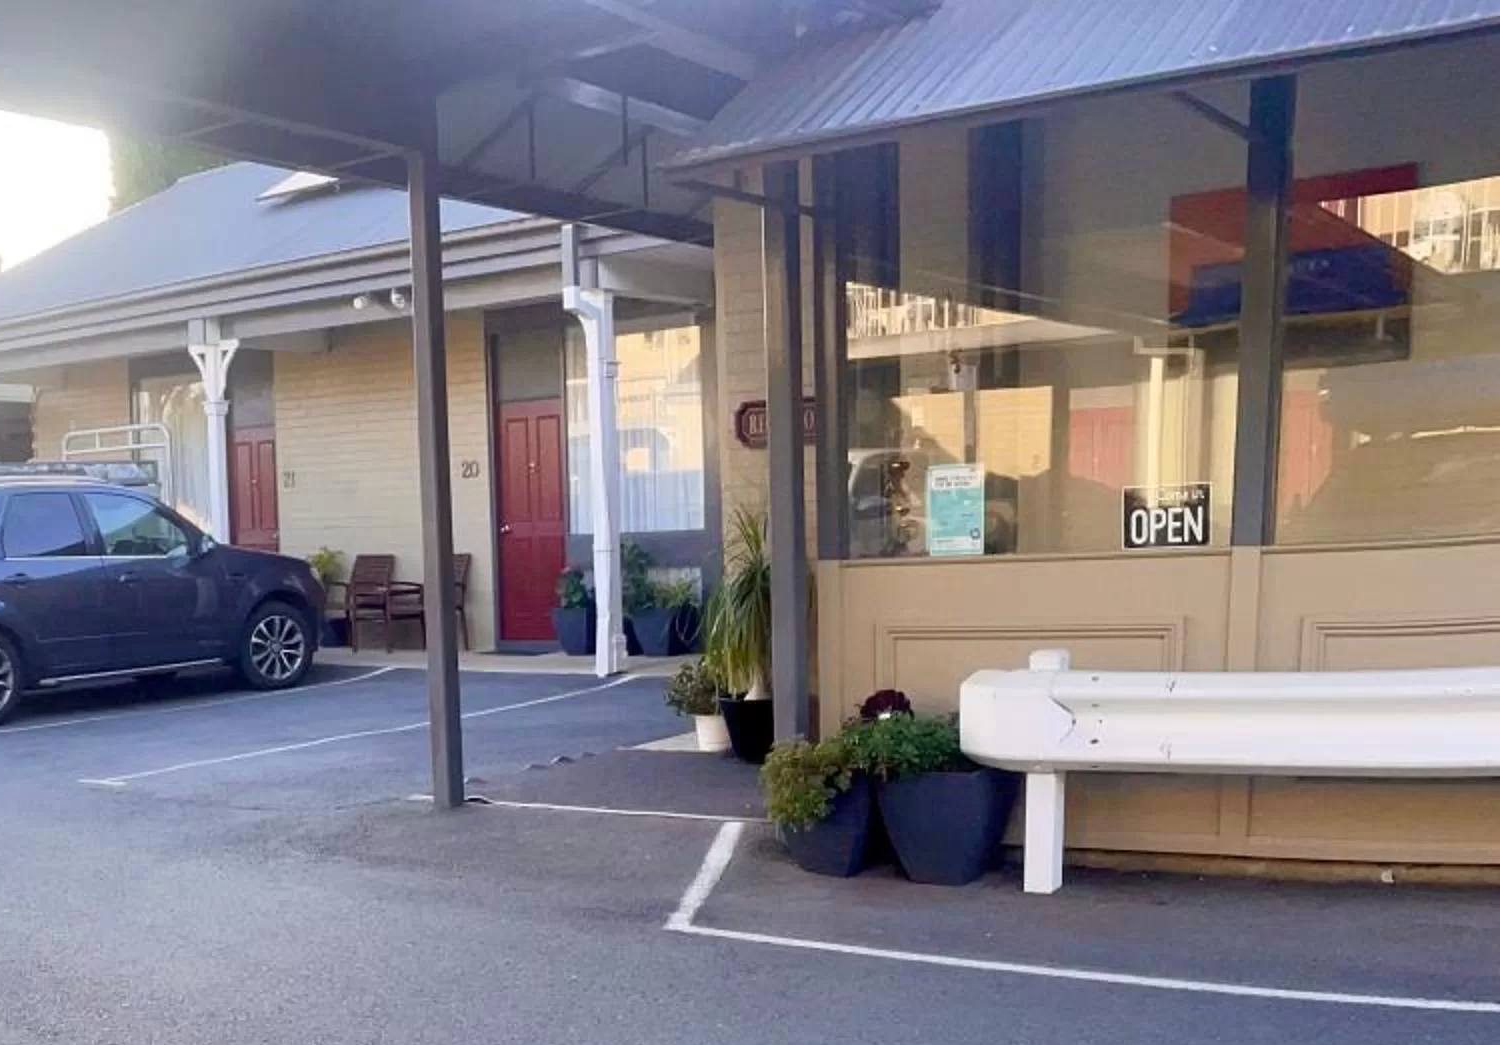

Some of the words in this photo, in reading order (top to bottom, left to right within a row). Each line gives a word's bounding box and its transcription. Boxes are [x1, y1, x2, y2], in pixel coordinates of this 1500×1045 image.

[461, 460, 479, 479] 20
[283, 470, 296, 489] 21
[1130, 506, 1203, 545] OPEN
